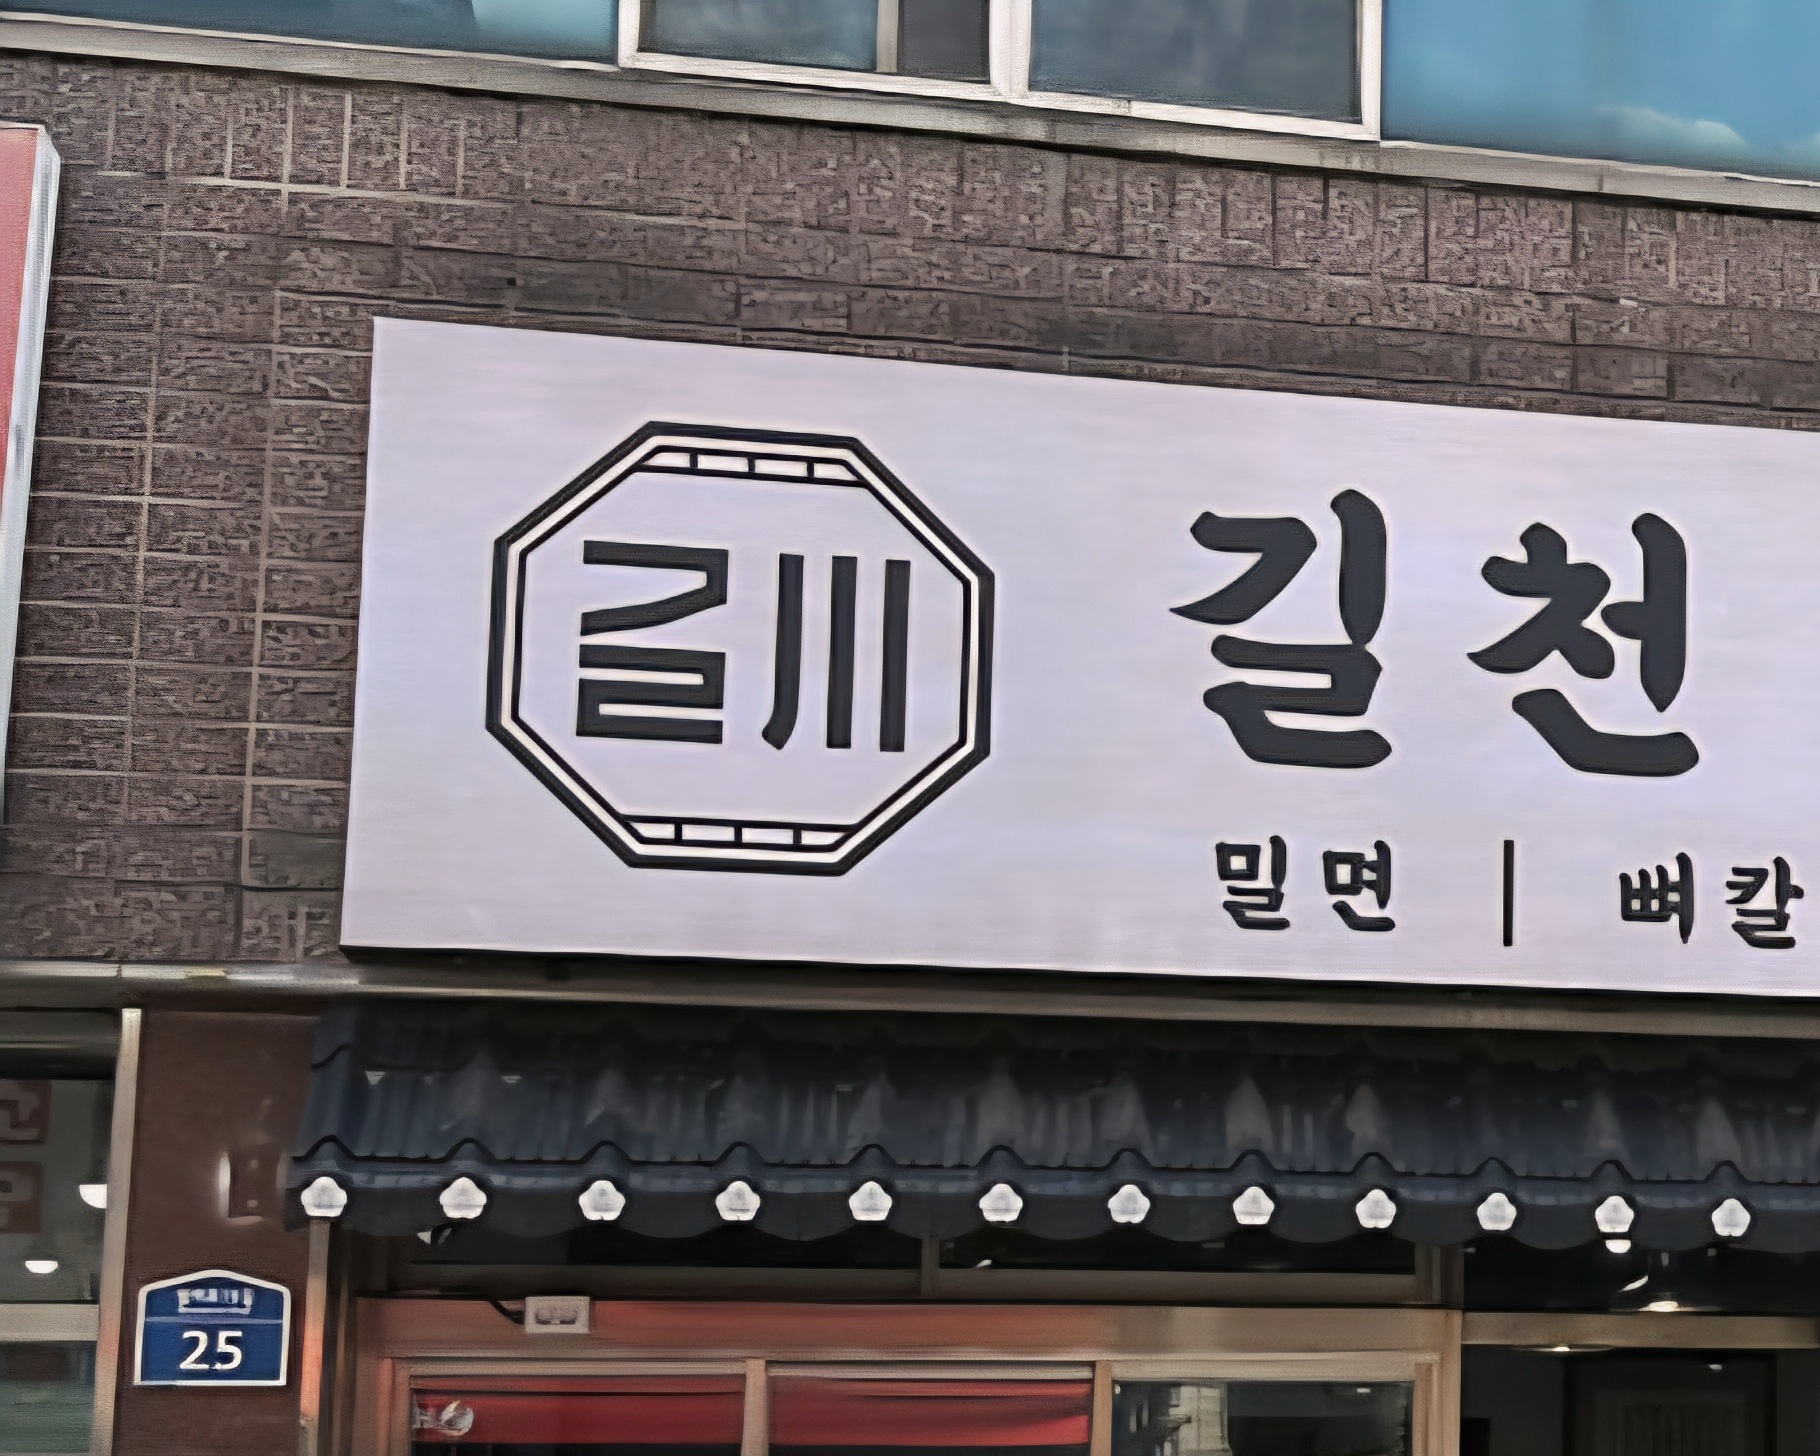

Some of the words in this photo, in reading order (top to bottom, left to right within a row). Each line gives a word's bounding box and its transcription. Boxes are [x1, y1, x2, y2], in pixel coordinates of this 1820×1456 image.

[1170, 489, 1699, 777] 길천
[1215, 835, 1396, 932] 밀면
[179, 1330, 243, 1371] 25
